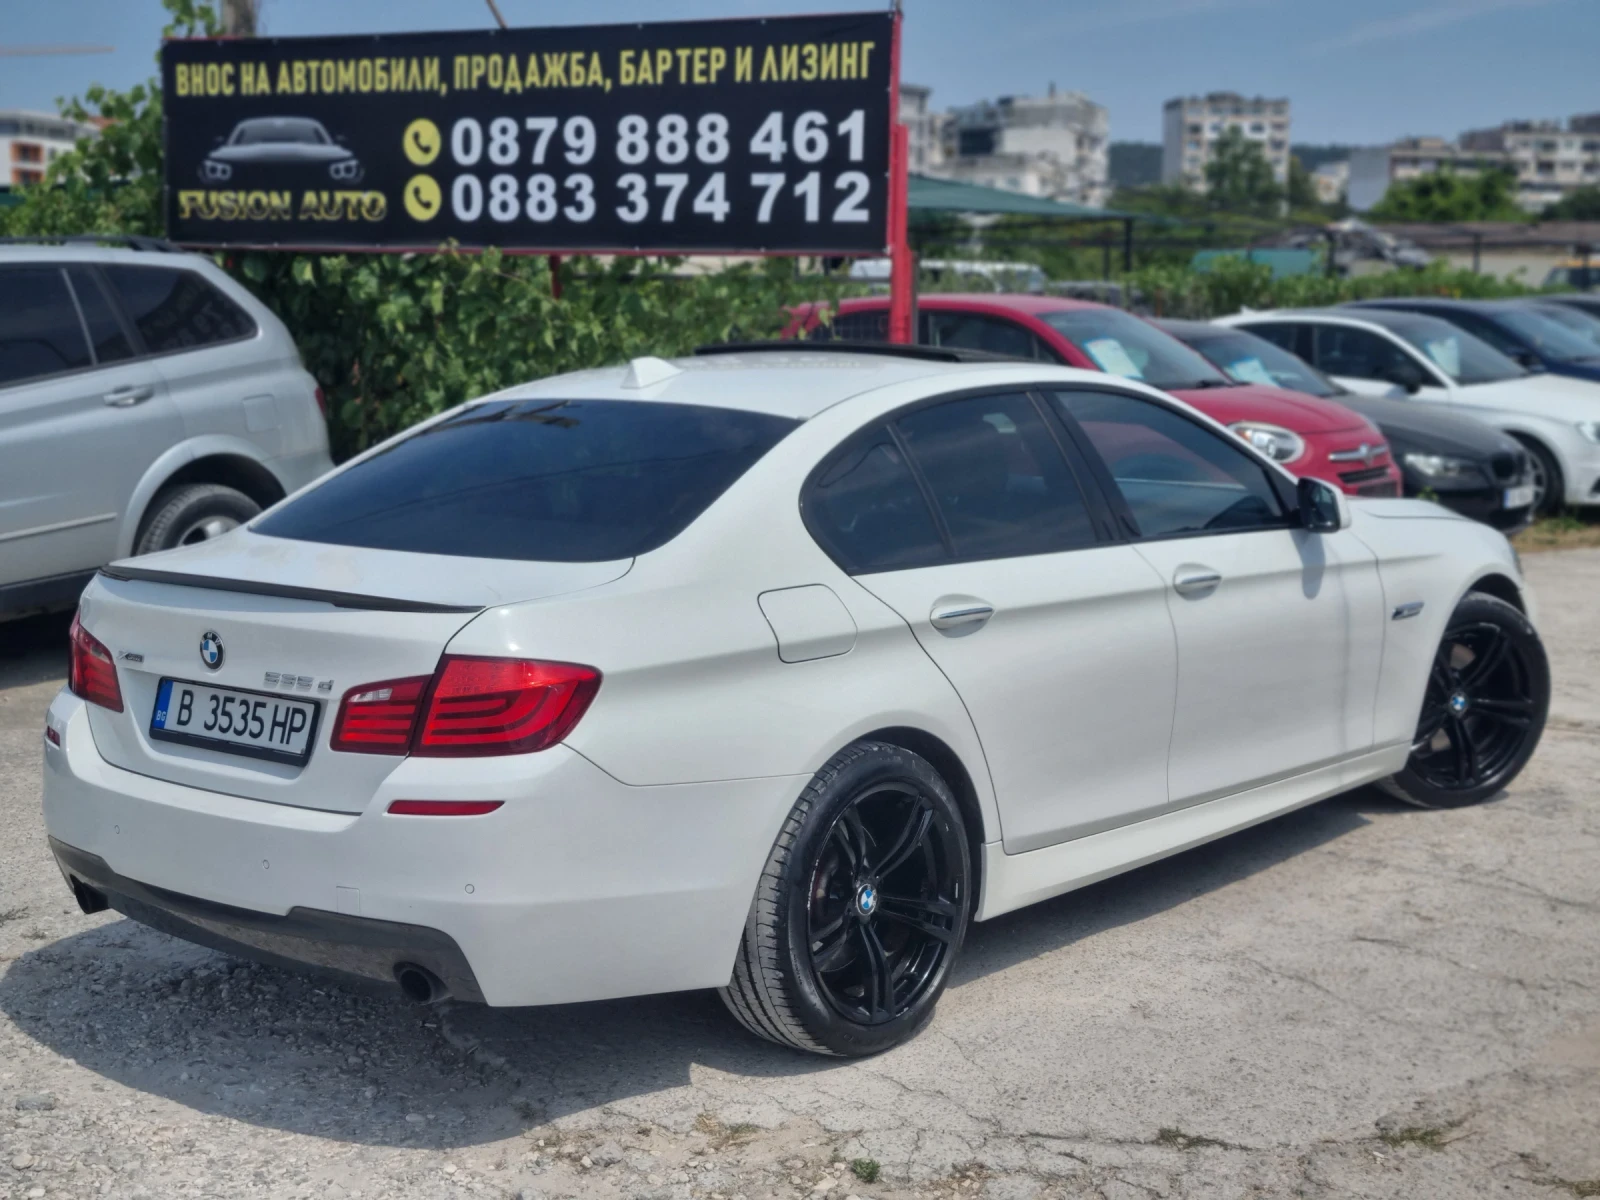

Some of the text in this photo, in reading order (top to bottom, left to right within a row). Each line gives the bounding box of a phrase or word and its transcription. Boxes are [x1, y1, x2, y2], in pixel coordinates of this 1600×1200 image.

[175, 42, 875, 95] ВНОС НА АВТОМОБИЛИ, ПРОДАЖБА, БАРТЕР И ЛИЗИНГ
[450, 109, 867, 167] 0879 888 461
[178, 190, 388, 221] FUSION AUTO
[451, 170, 871, 223] 0883 374 712
[155, 709, 167, 722] BG
[176, 688, 307, 745] B 3535 HP
